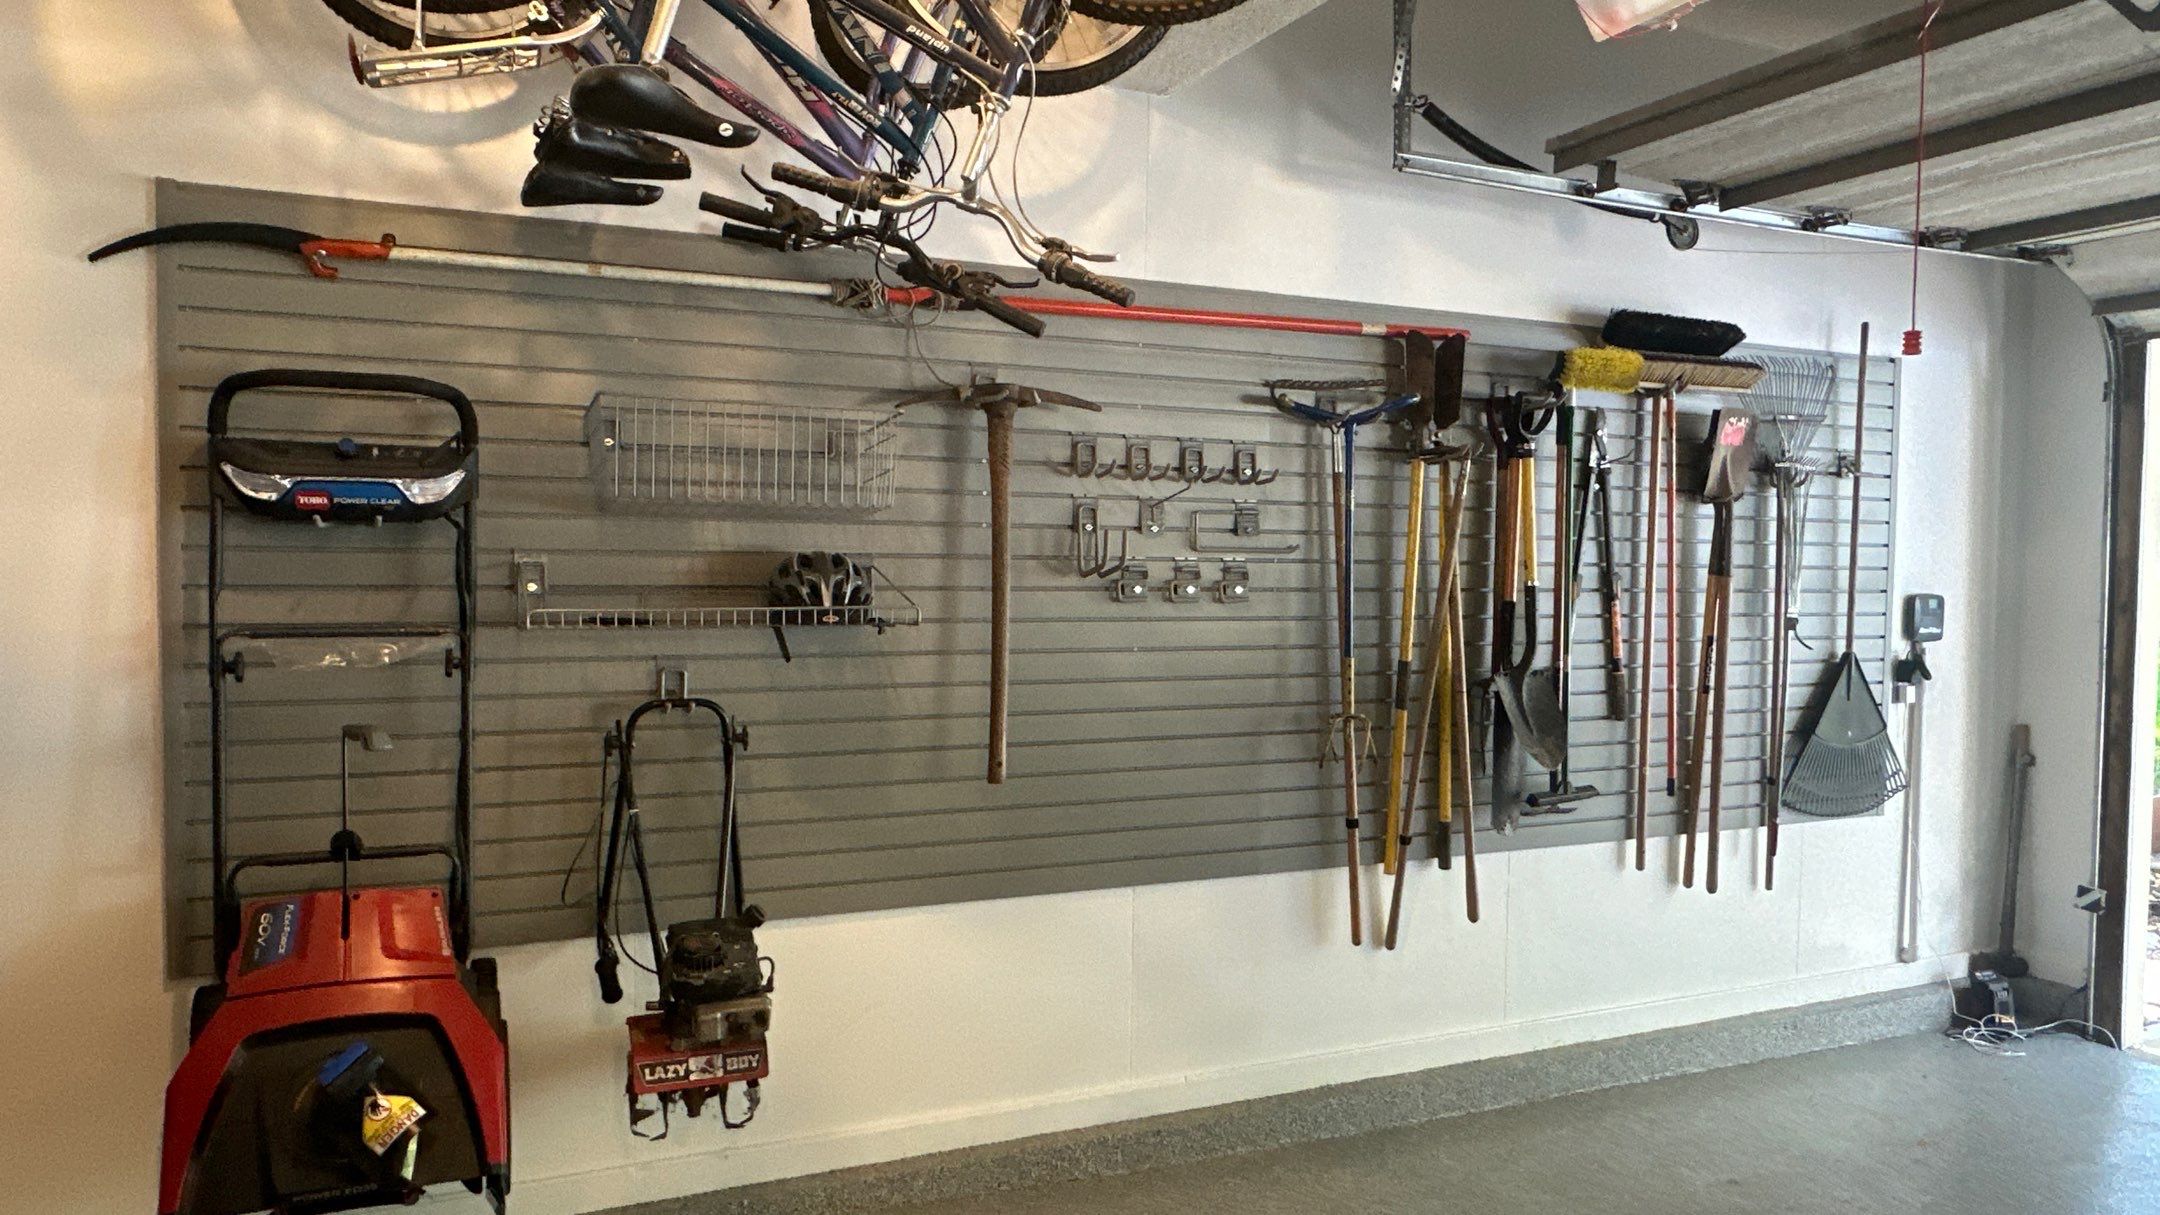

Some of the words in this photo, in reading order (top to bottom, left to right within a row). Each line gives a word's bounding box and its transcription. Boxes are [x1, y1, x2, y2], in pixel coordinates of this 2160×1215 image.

[906, 24, 950, 54] upland
[298, 496, 328, 505] TORO
[333, 497, 368, 505] POWER
[370, 497, 401, 505] CLEAR
[644, 1063, 688, 1080] LAZY
[726, 1054, 760, 1071] BOY
[378, 1109, 419, 1148] DANGER
